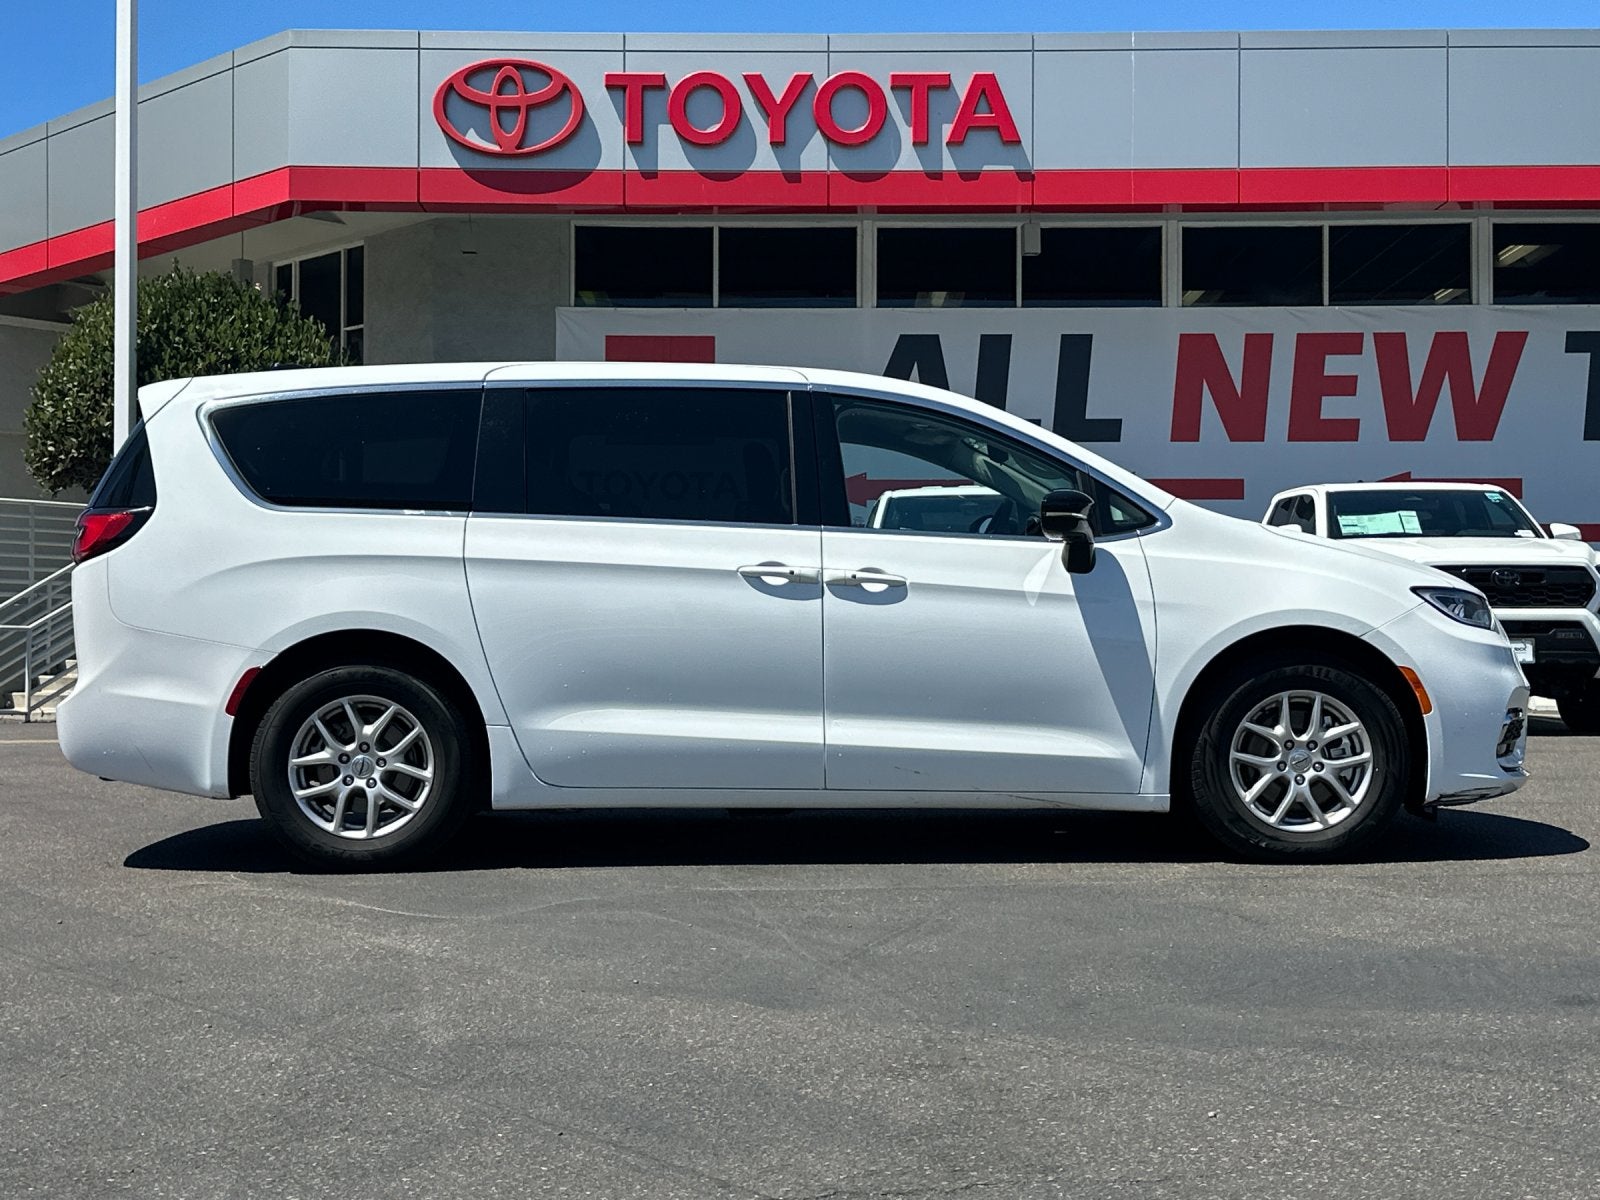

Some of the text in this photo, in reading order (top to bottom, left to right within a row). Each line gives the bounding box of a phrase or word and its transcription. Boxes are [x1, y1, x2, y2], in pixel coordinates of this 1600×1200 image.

[605, 71, 1021, 146] TOYOTA
[1170, 331, 1529, 442] NEW
[578, 470, 742, 500] TOYOTA
